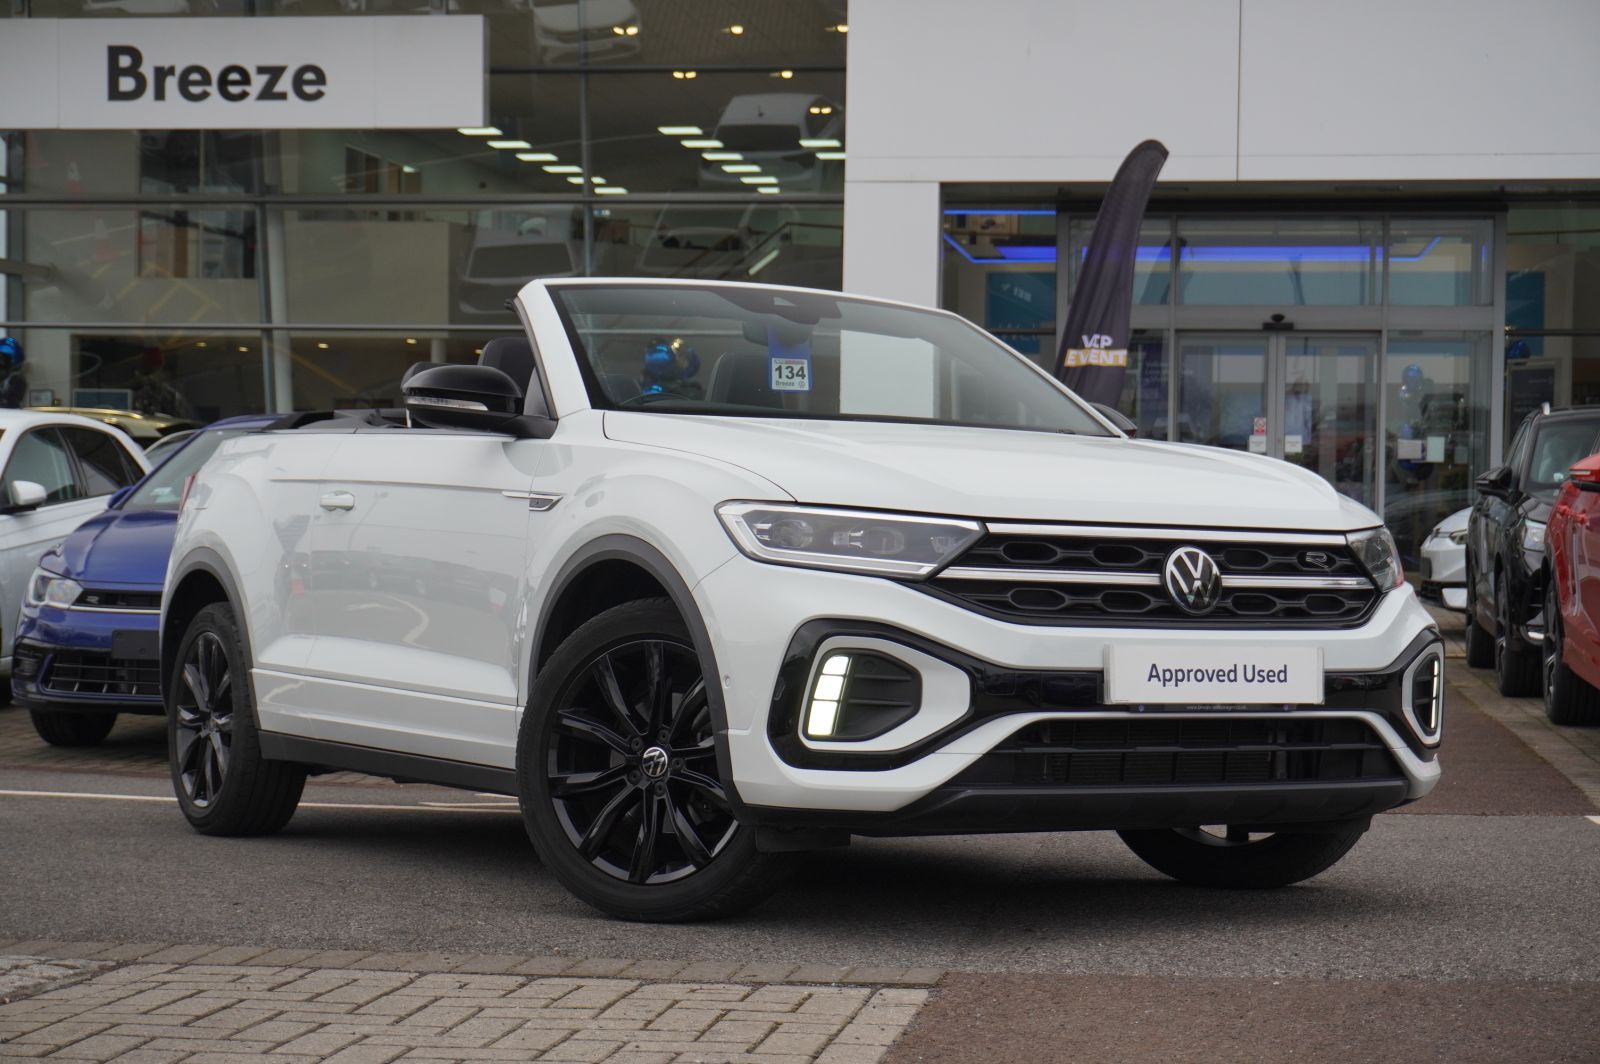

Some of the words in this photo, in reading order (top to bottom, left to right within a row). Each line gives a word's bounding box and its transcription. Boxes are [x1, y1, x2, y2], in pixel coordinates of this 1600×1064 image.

[107, 45, 327, 102] Breeze
[1081, 333, 1113, 349] VIP
[1066, 348, 1128, 366] EVENT
[775, 365, 806, 380] 134
[1147, 663, 1238, 688] Approved
[1243, 664, 1289, 683] Used
